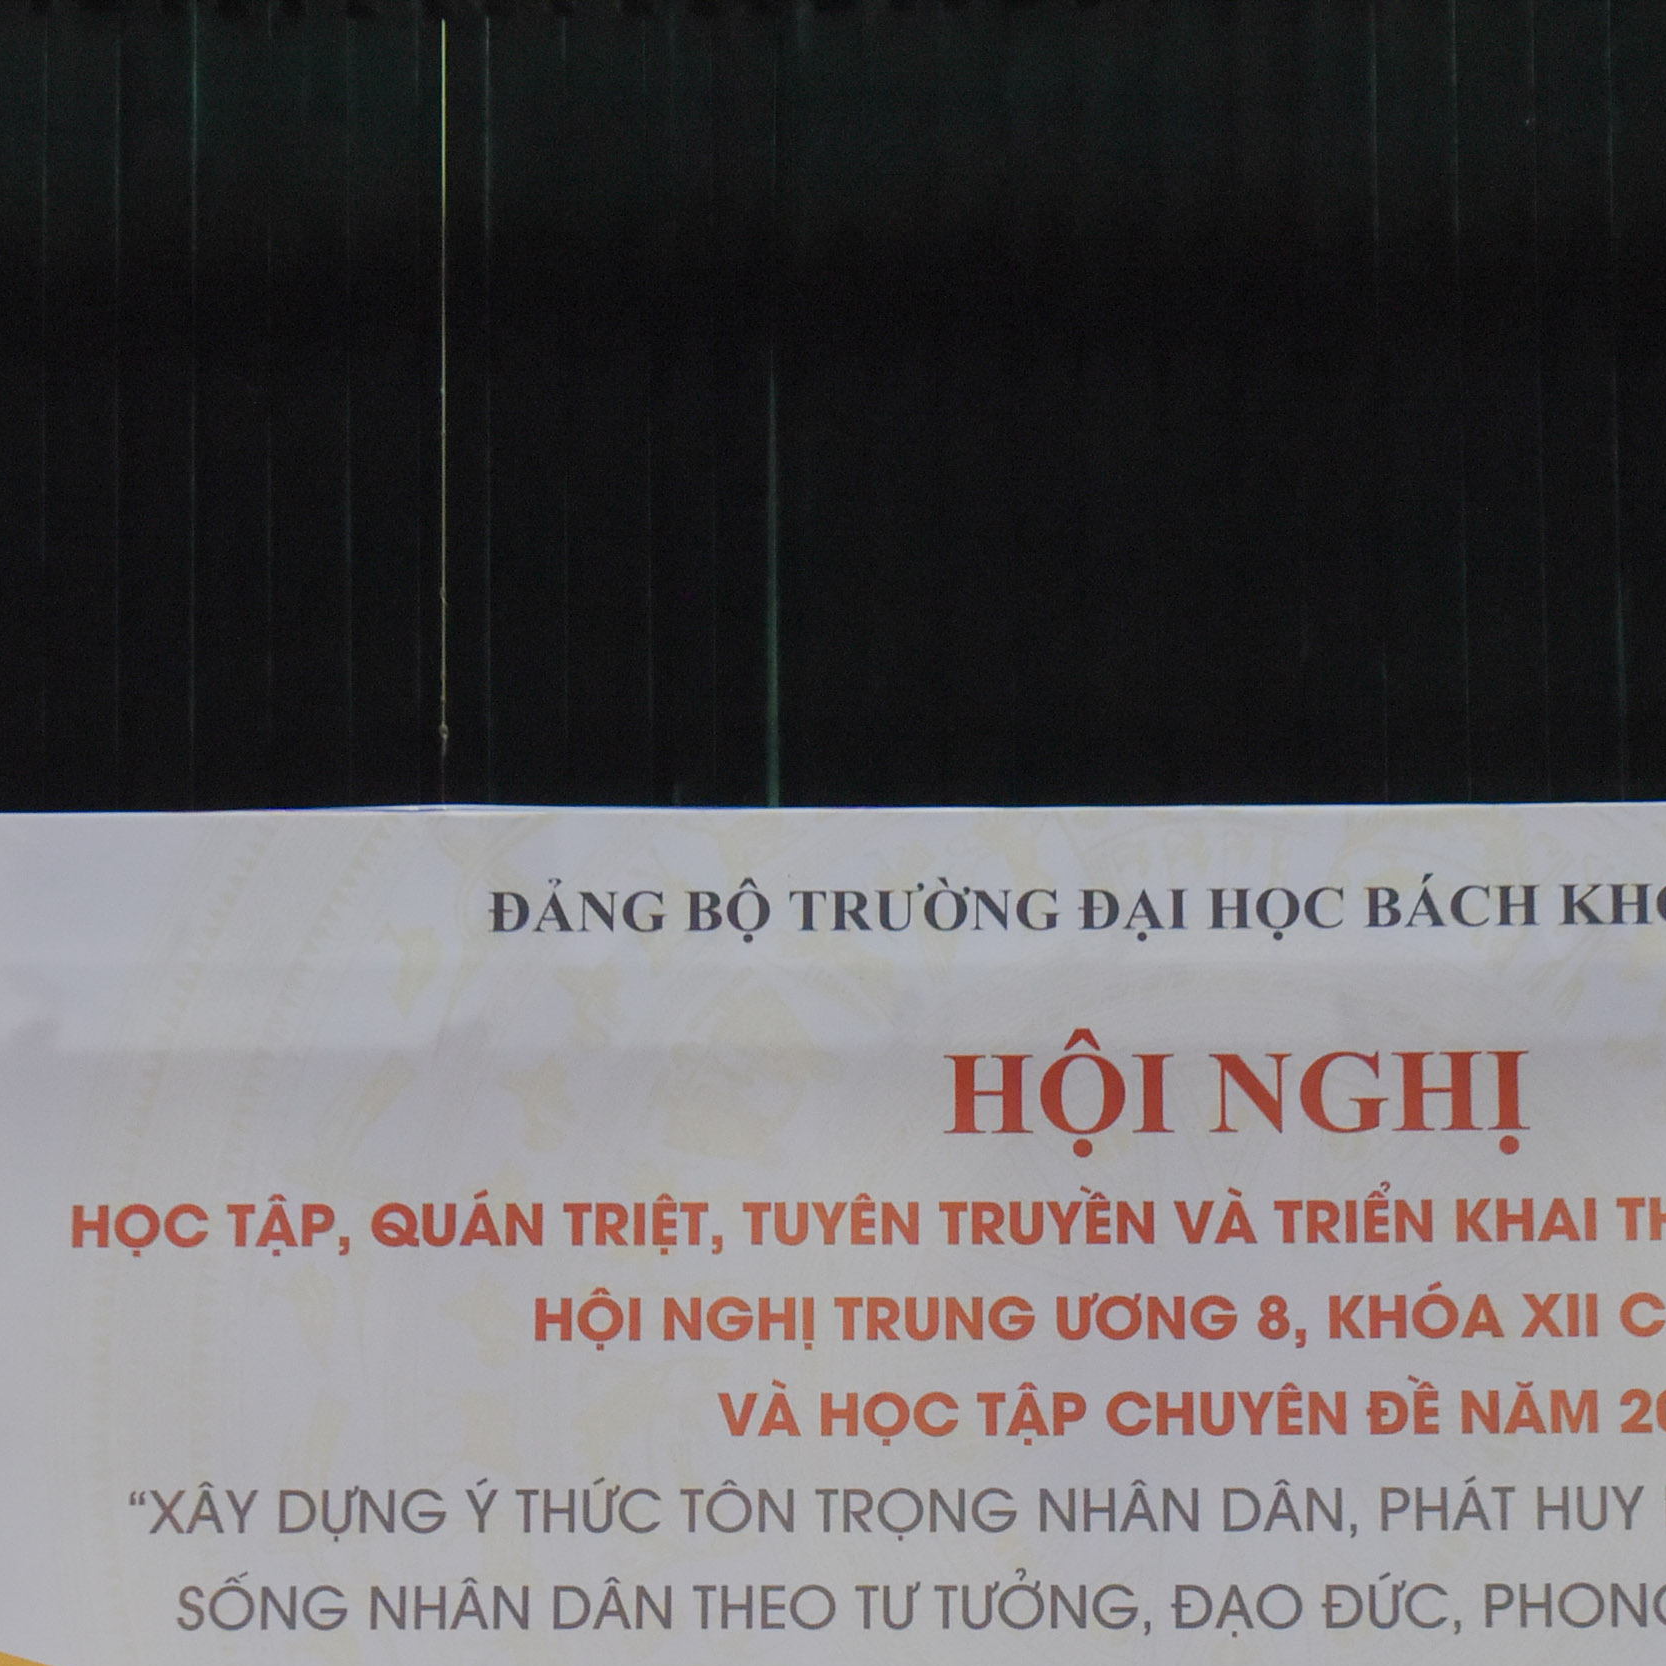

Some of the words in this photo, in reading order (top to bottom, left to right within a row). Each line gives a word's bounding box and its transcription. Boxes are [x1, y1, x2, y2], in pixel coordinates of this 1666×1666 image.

[488, 877, 666, 933] ĐẢNG
[684, 876, 771, 944] BỘ
[788, 876, 1060, 933] TRƯỜNG
[1077, 888, 1188, 943] ĐẠI
[1208, 886, 1344, 942] HỌC
[1364, 872, 1540, 928] BÁCH
[943, 1027, 1175, 1159] HỘI
[1208, 1049, 1531, 1156] NGHỊ
[71, 1202, 210, 1258] HỌC
[226, 1193, 351, 1257] TẬP,
[370, 1188, 544, 1248] QUÁN
[562, 1192, 724, 1257] TRIỆT,
[742, 1191, 920, 1247] TUYÊN
[938, 1185, 1155, 1246] TRUYỀN
[1173, 1186, 1258, 1245] VÀ
[1273, 1180, 1434, 1245] TRIỂN
[1455, 1196, 1598, 1243] KHAI
[534, 1286, 642, 1352] HỘI
[663, 1295, 815, 1351] NGHỊ
[833, 1295, 1036, 1342] TRUNG
[1055, 1292, 1238, 1341] ƯƠNG
[1257, 1294, 1307, 1349] 8,
[1328, 1280, 1506, 1340] KHÓA
[1520, 1292, 1599, 1338] XII
[717, 1378, 802, 1437] VÀ
[820, 1391, 960, 1447] HỌC
[976, 1381, 1087, 1447] TẬP
[1105, 1381, 1348, 1437] CHUYÊN
[1365, 1374, 1440, 1436] ĐỀ
[1460, 1380, 1599, 1435] NĂM
[129, 1480, 259, 1535] “XÂY
[278, 1485, 447, 1543] DỰNG
[465, 1477, 499, 1534] Ý
[515, 1476, 662, 1534] THỨC
[679, 1479, 795, 1534] TÔN
[814, 1487, 1018, 1542] TRỌNG
[1039, 1478, 1200, 1533] NHÂN
[1223, 1478, 1358, 1539] DÂN,
[1380, 1475, 1516, 1532] PHÁT
[1536, 1485, 1645, 1532] HUY
[176, 1571, 348, 1632] SỐNG
[369, 1576, 530, 1631] NHÂN
[552, 1576, 672, 1630] DÂN
[692, 1583, 837, 1631] THEO
[854, 1580, 921, 1631] TƯ
[933, 1567, 1151, 1637] TƯỞNG,
[1170, 1583, 1303, 1638] ĐẠO
[1321, 1571, 1462, 1636] ĐỨC,
